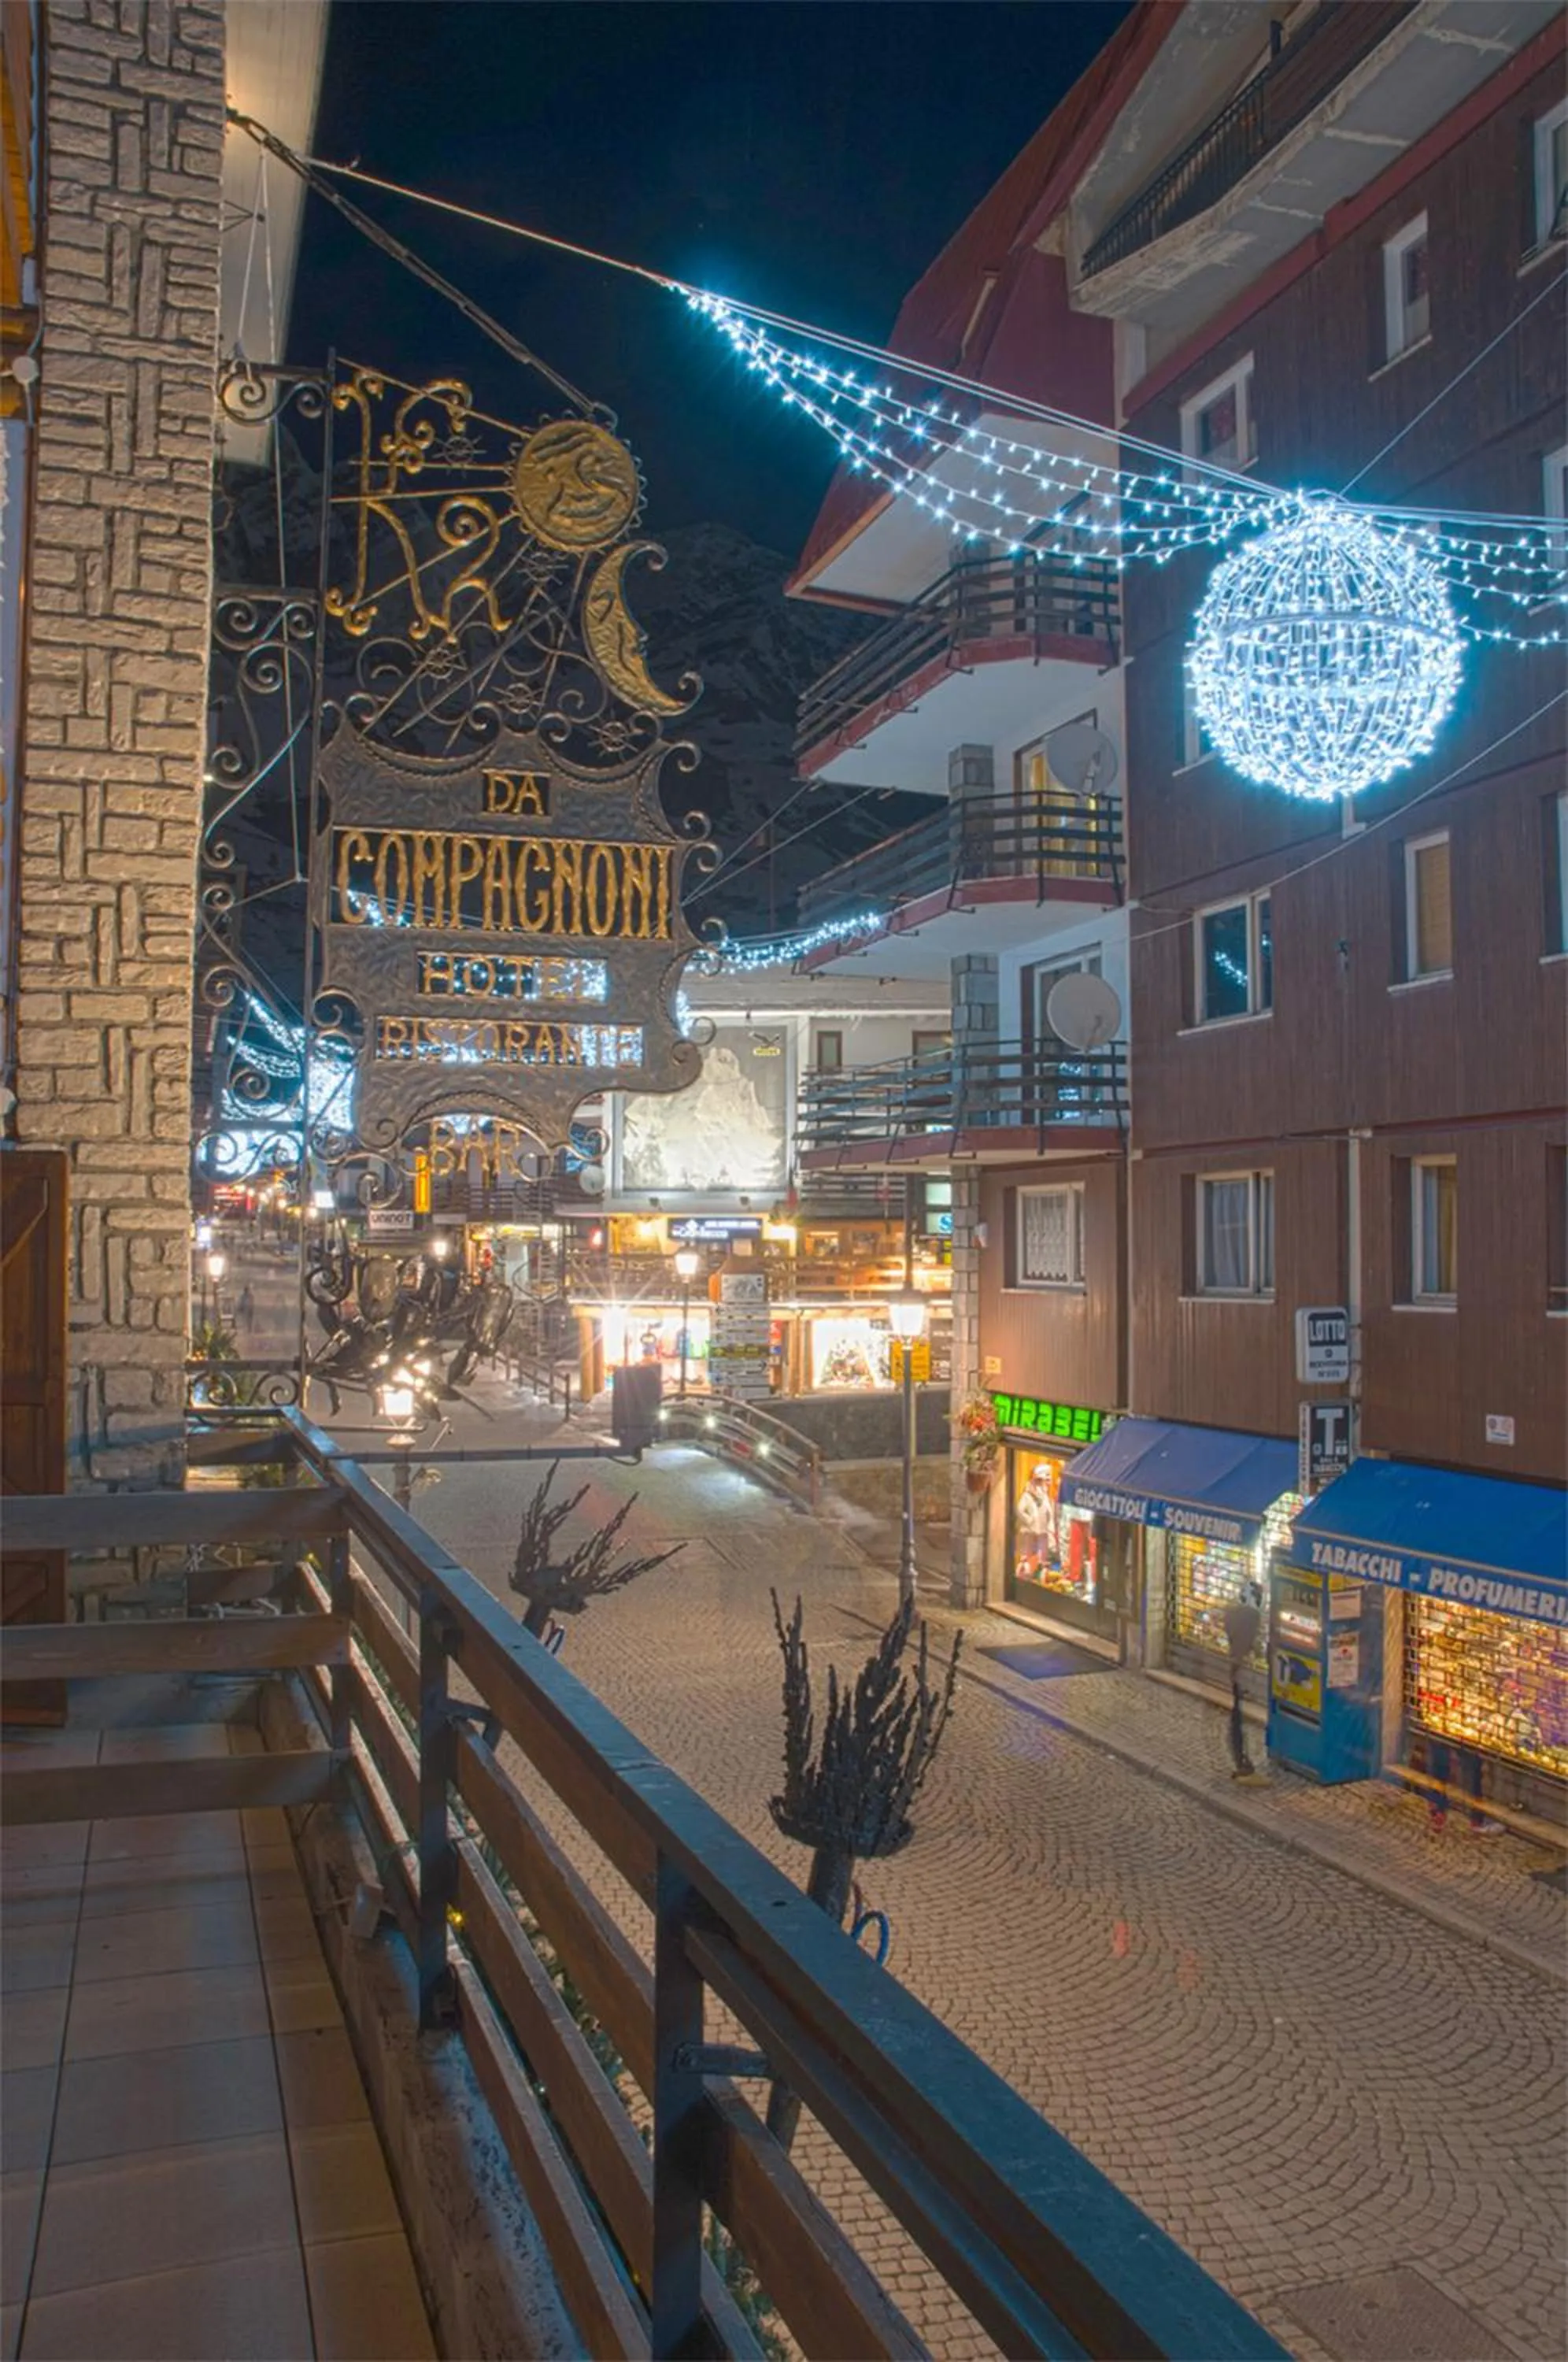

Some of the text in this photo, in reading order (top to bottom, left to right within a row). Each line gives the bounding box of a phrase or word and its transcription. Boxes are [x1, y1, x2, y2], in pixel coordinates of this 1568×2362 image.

[486, 768, 545, 814] DA
[337, 831, 670, 939] COMPAGNONI
[430, 1118, 521, 1175] BAR
[1309, 1320, 1345, 1342] LOTTO
[1316, 1408, 1344, 1456] T
[1074, 1487, 1145, 1520] GIOCATTOLI
[1164, 1506, 1241, 1542] SOUVENIR
[1311, 1542, 1402, 1583] TABACCHI
[1428, 1567, 1568, 1623] PROFUMERI
